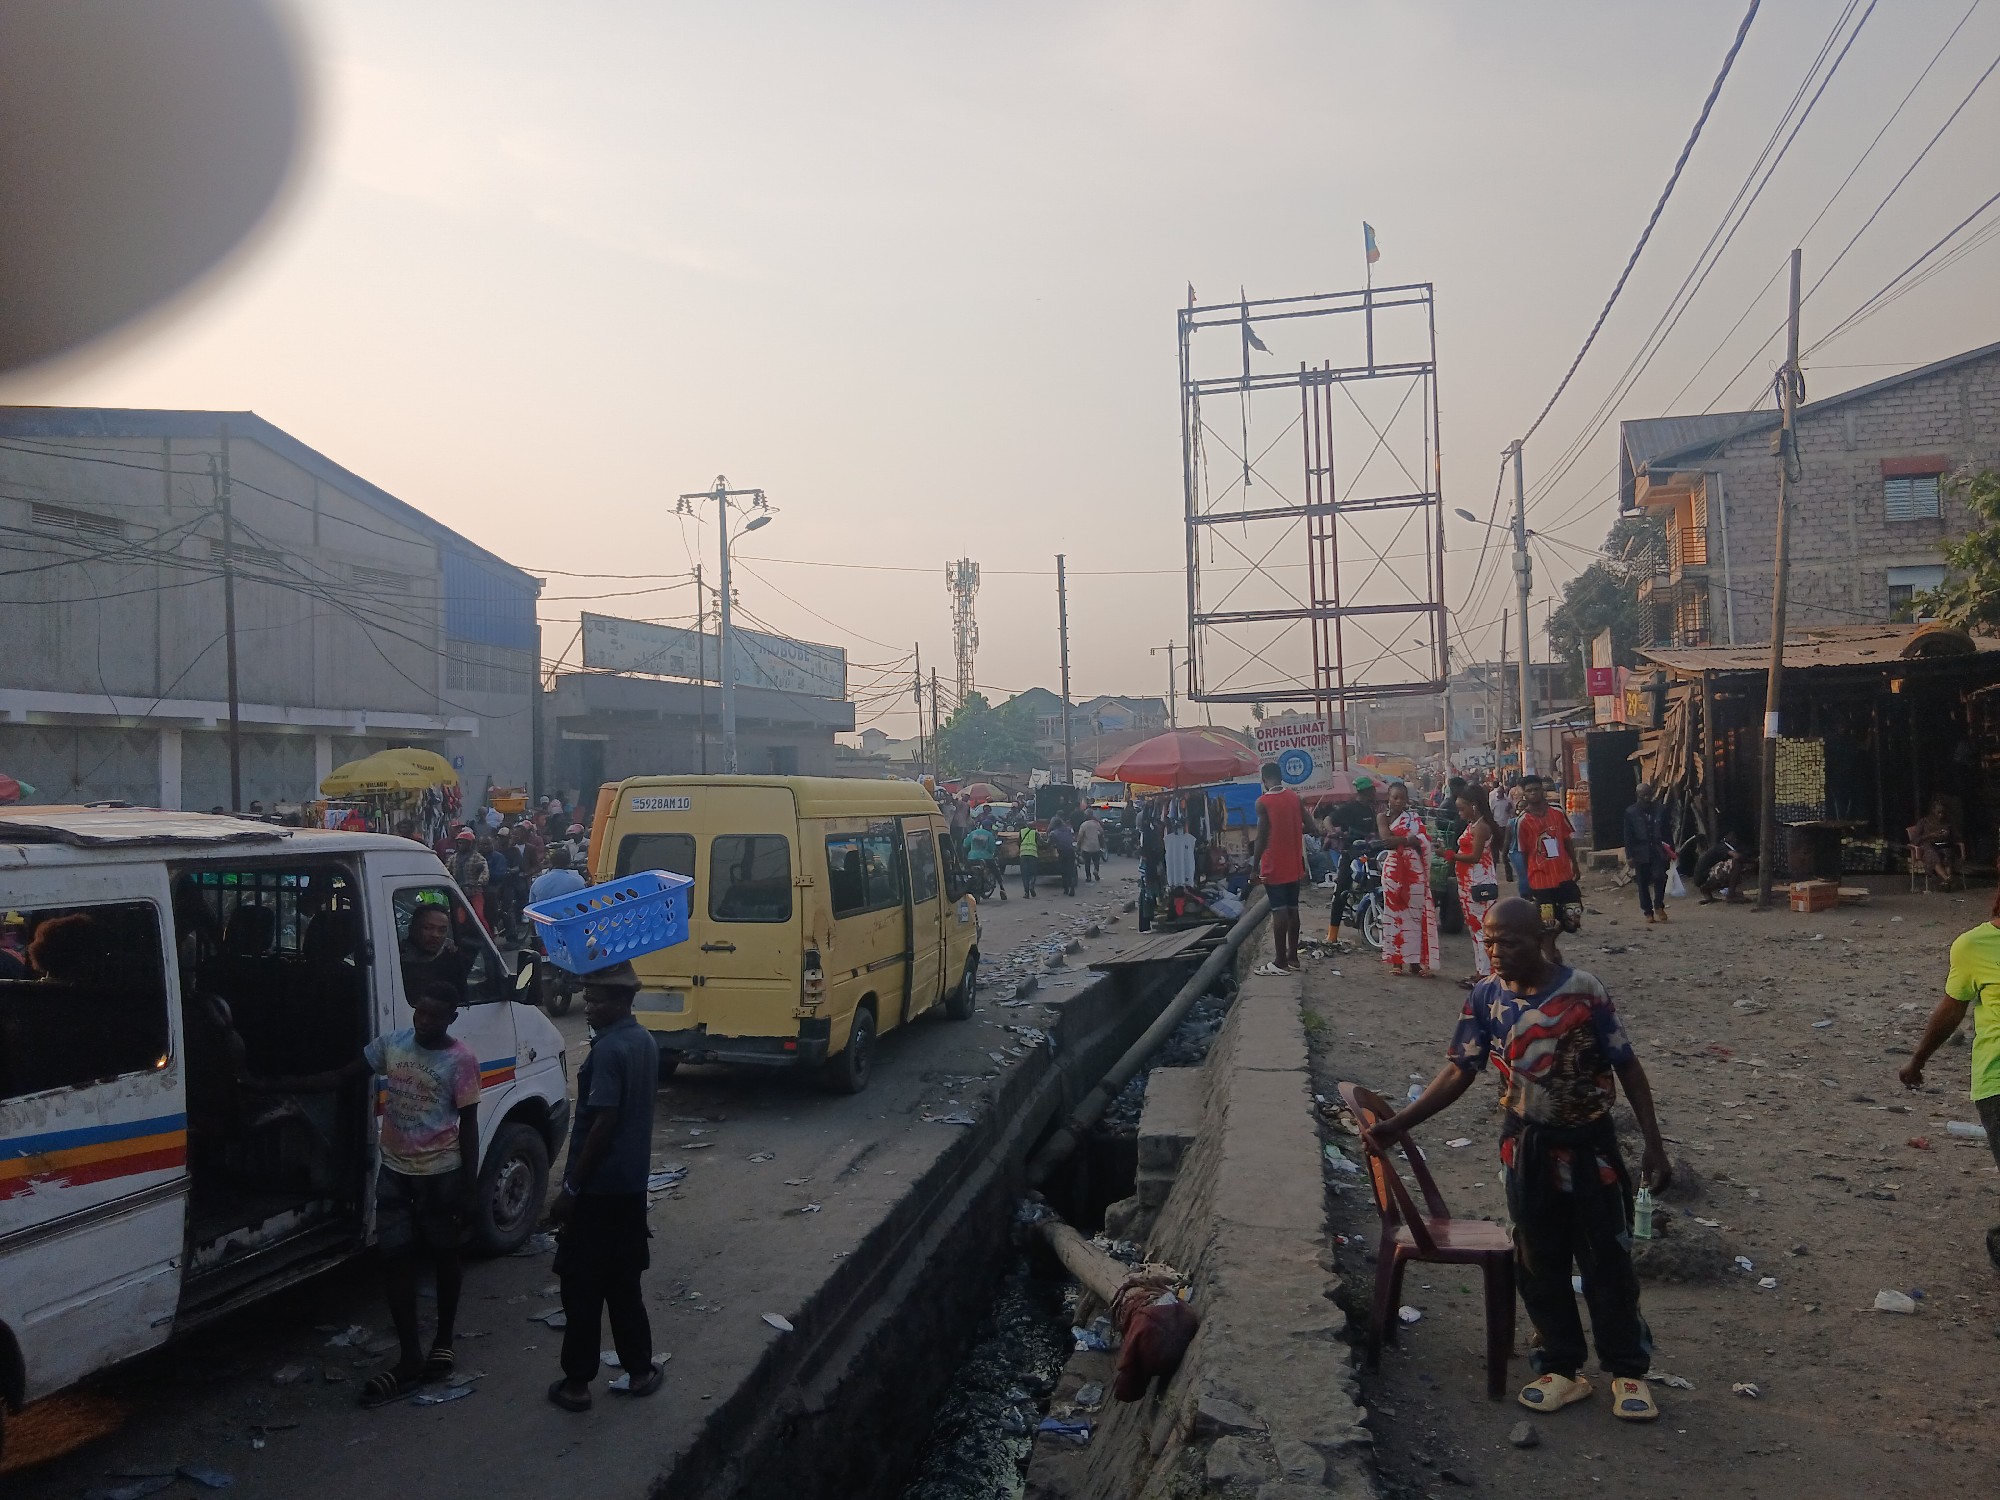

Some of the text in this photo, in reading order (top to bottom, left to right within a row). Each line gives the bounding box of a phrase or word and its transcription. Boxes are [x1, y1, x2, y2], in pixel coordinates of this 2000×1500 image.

[1256, 722, 1325, 739] ORPHELINAT
[1257, 734, 1330, 752] CITE DE VICTOIRE
[640, 798, 690, 809] 5928AM 10
